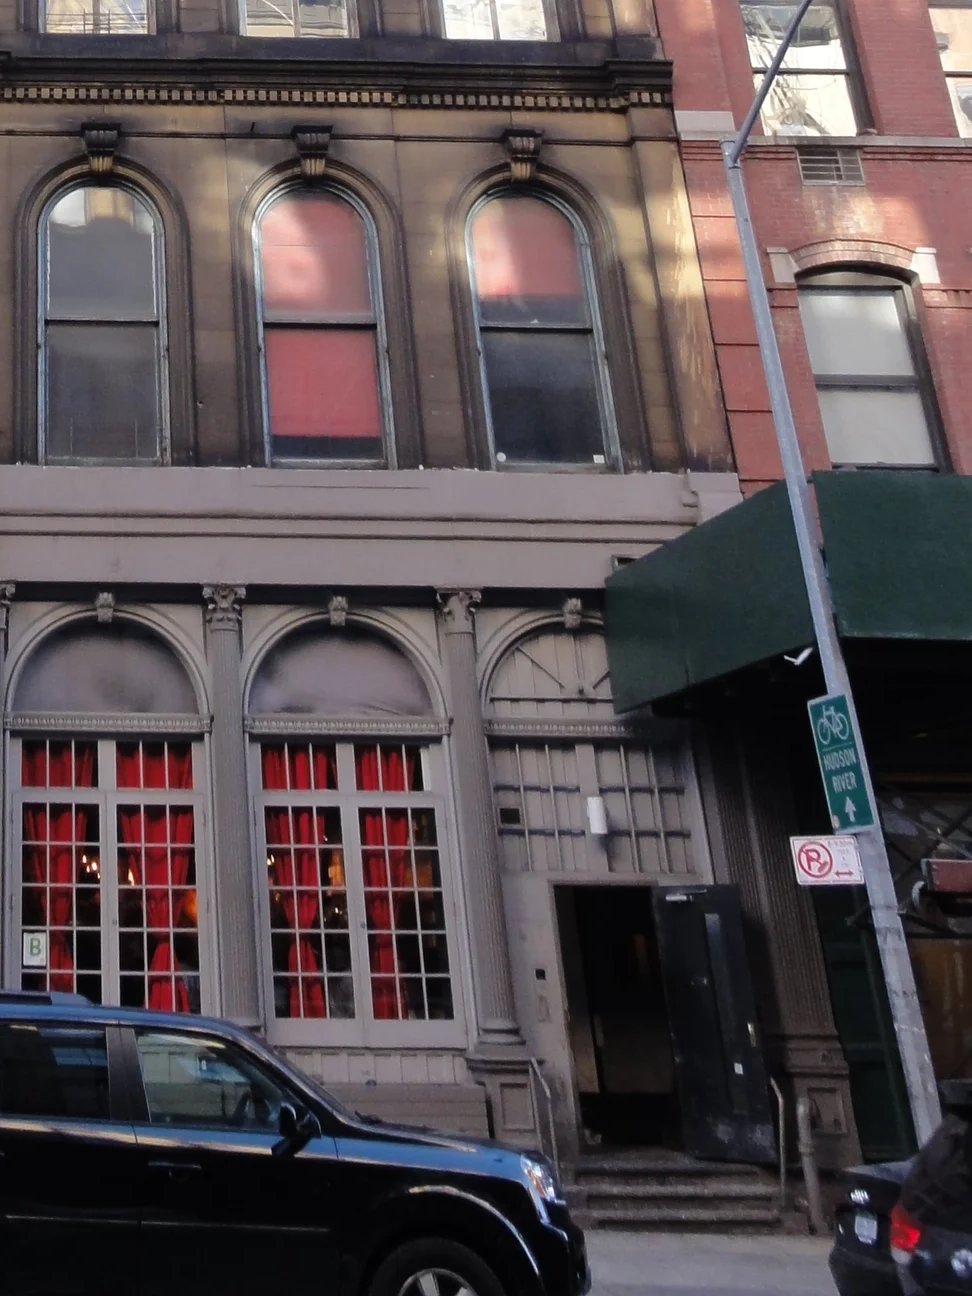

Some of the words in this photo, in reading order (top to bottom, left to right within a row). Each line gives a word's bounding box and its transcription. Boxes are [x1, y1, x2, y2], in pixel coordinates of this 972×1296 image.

[823, 748, 856, 770] HUDSON
[832, 772, 857, 792] RIVER
[30, 938, 41, 956] B
